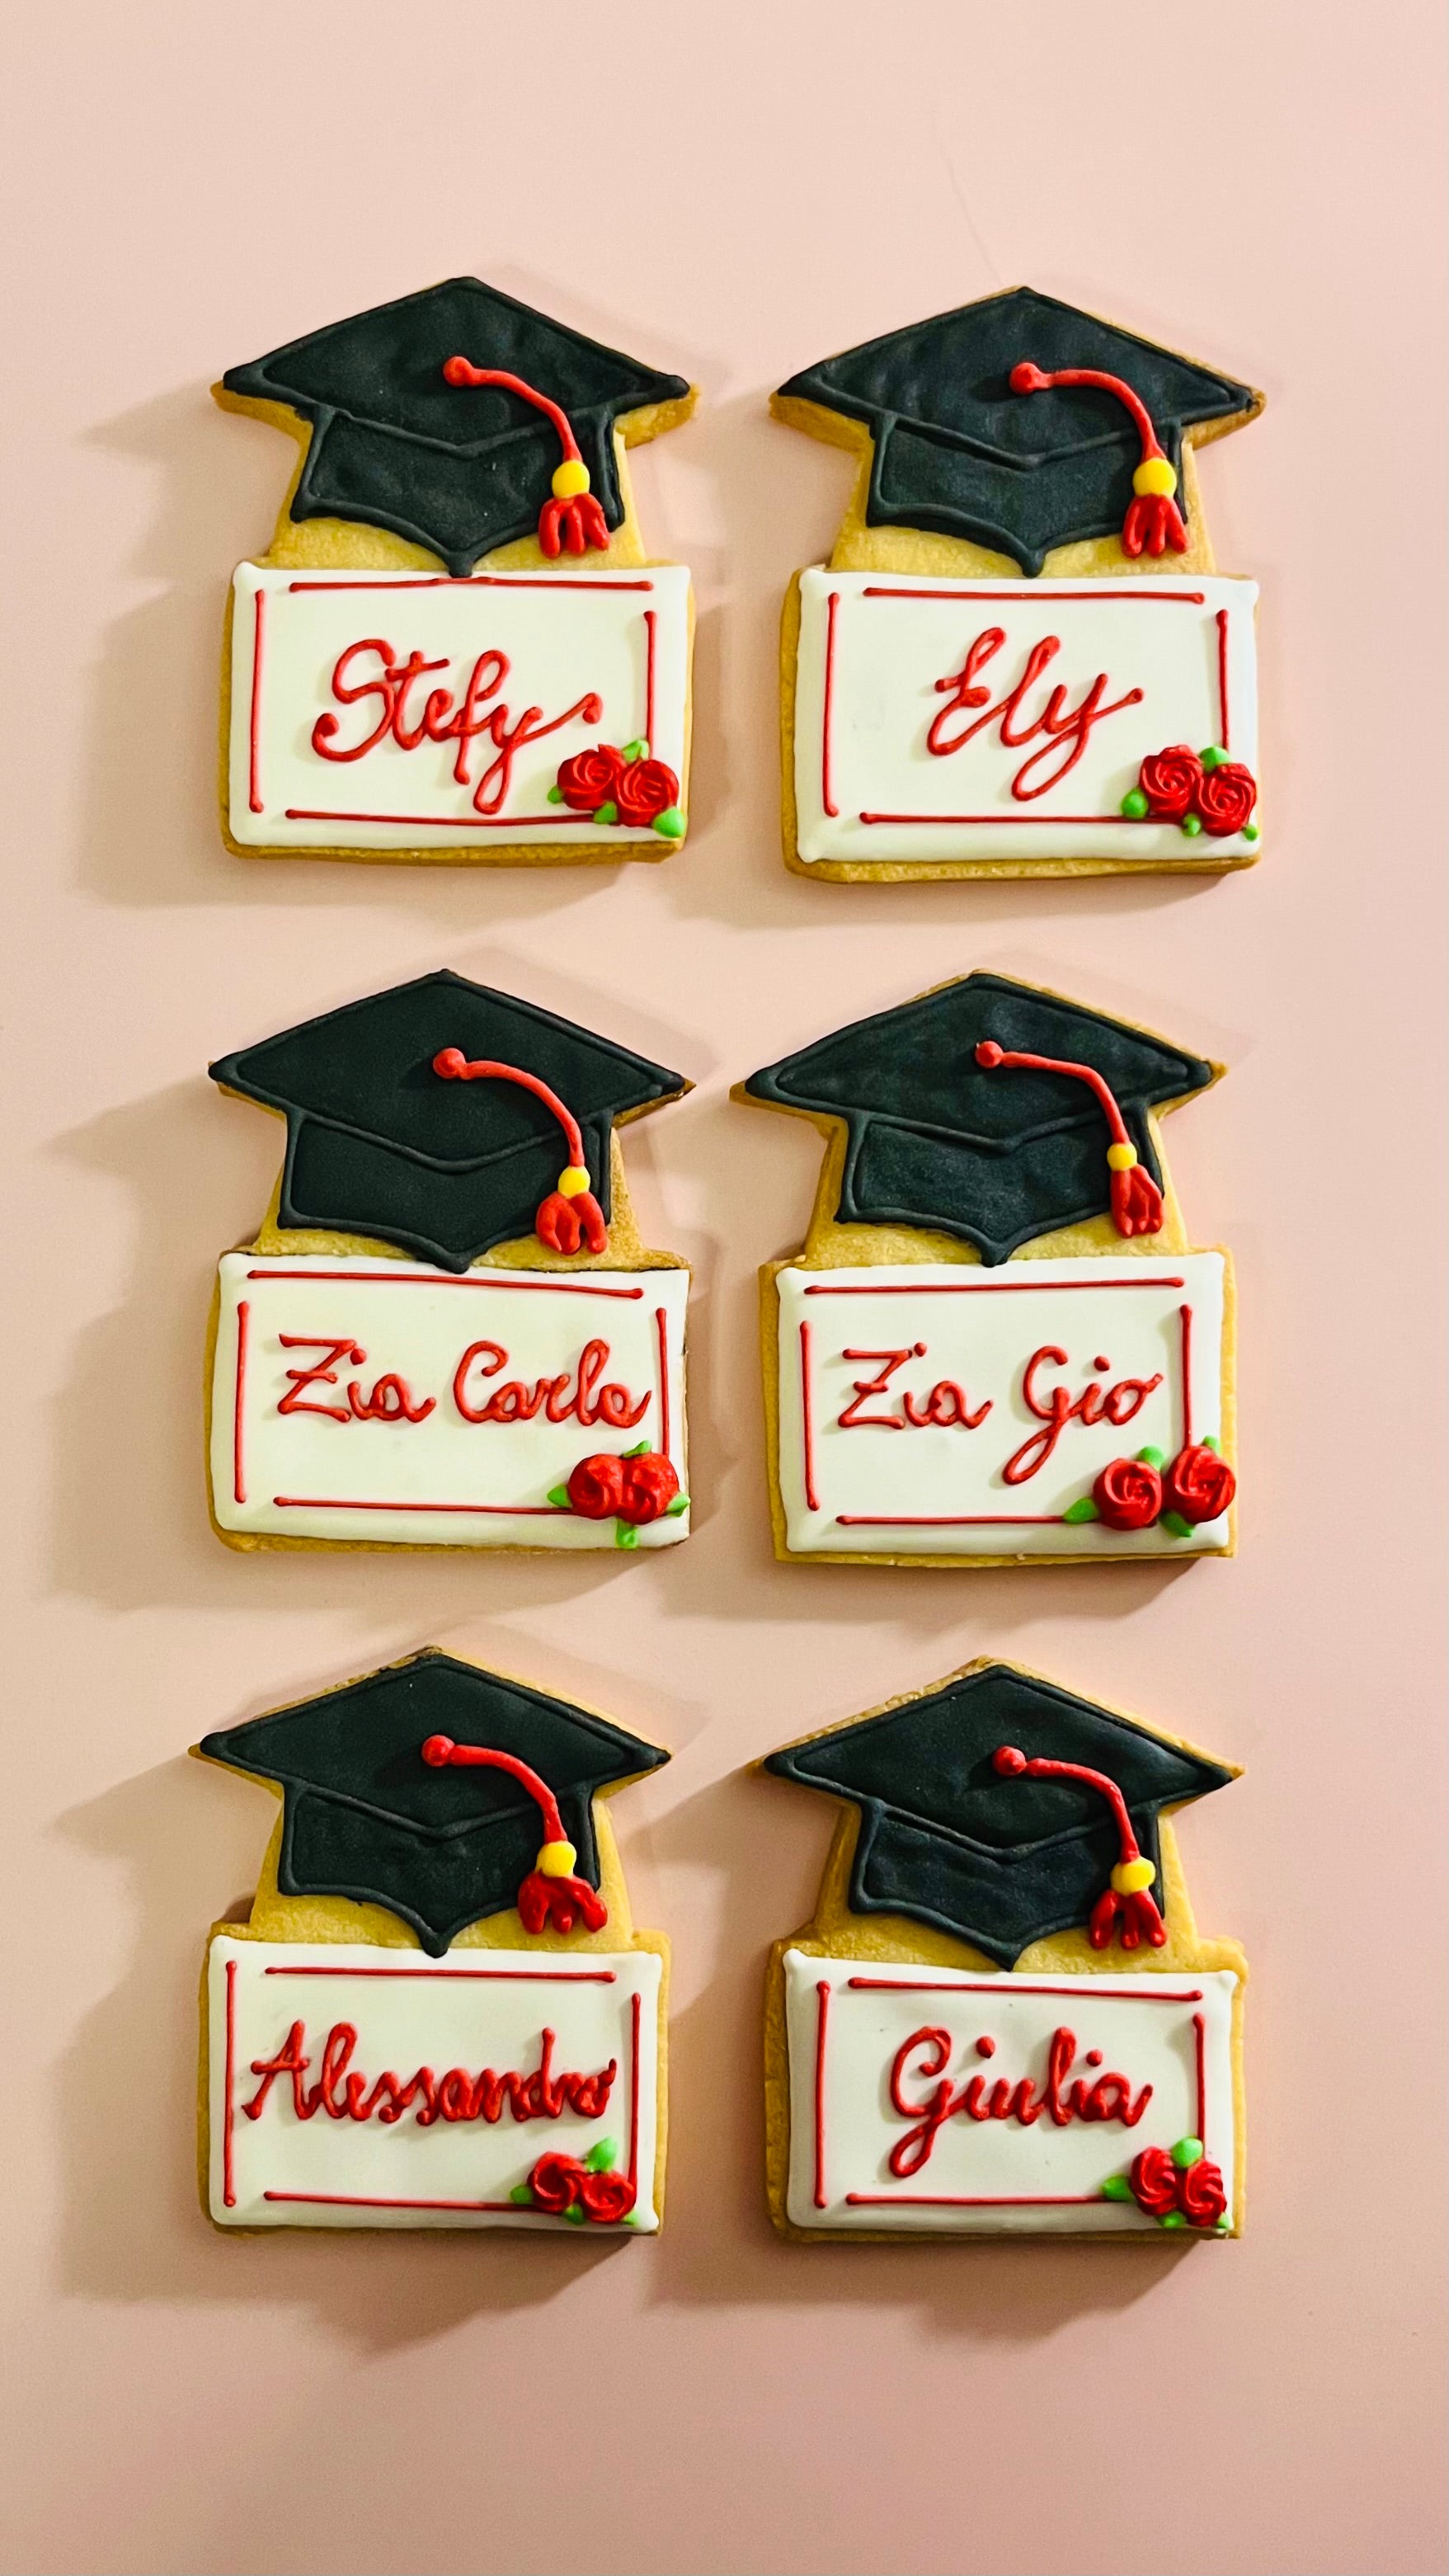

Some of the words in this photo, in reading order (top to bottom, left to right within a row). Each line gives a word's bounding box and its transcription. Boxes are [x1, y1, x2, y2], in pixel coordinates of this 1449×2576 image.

[312, 639, 602, 815] Stefy
[926, 628, 1143, 801] Ely
[277, 1334, 437, 1424] Zia
[838, 1342, 993, 1429] Zia
[1002, 1345, 1163, 1485] Gio
[242, 2020, 617, 2126] Alessandro
[887, 2026, 1153, 2179] Giulia
